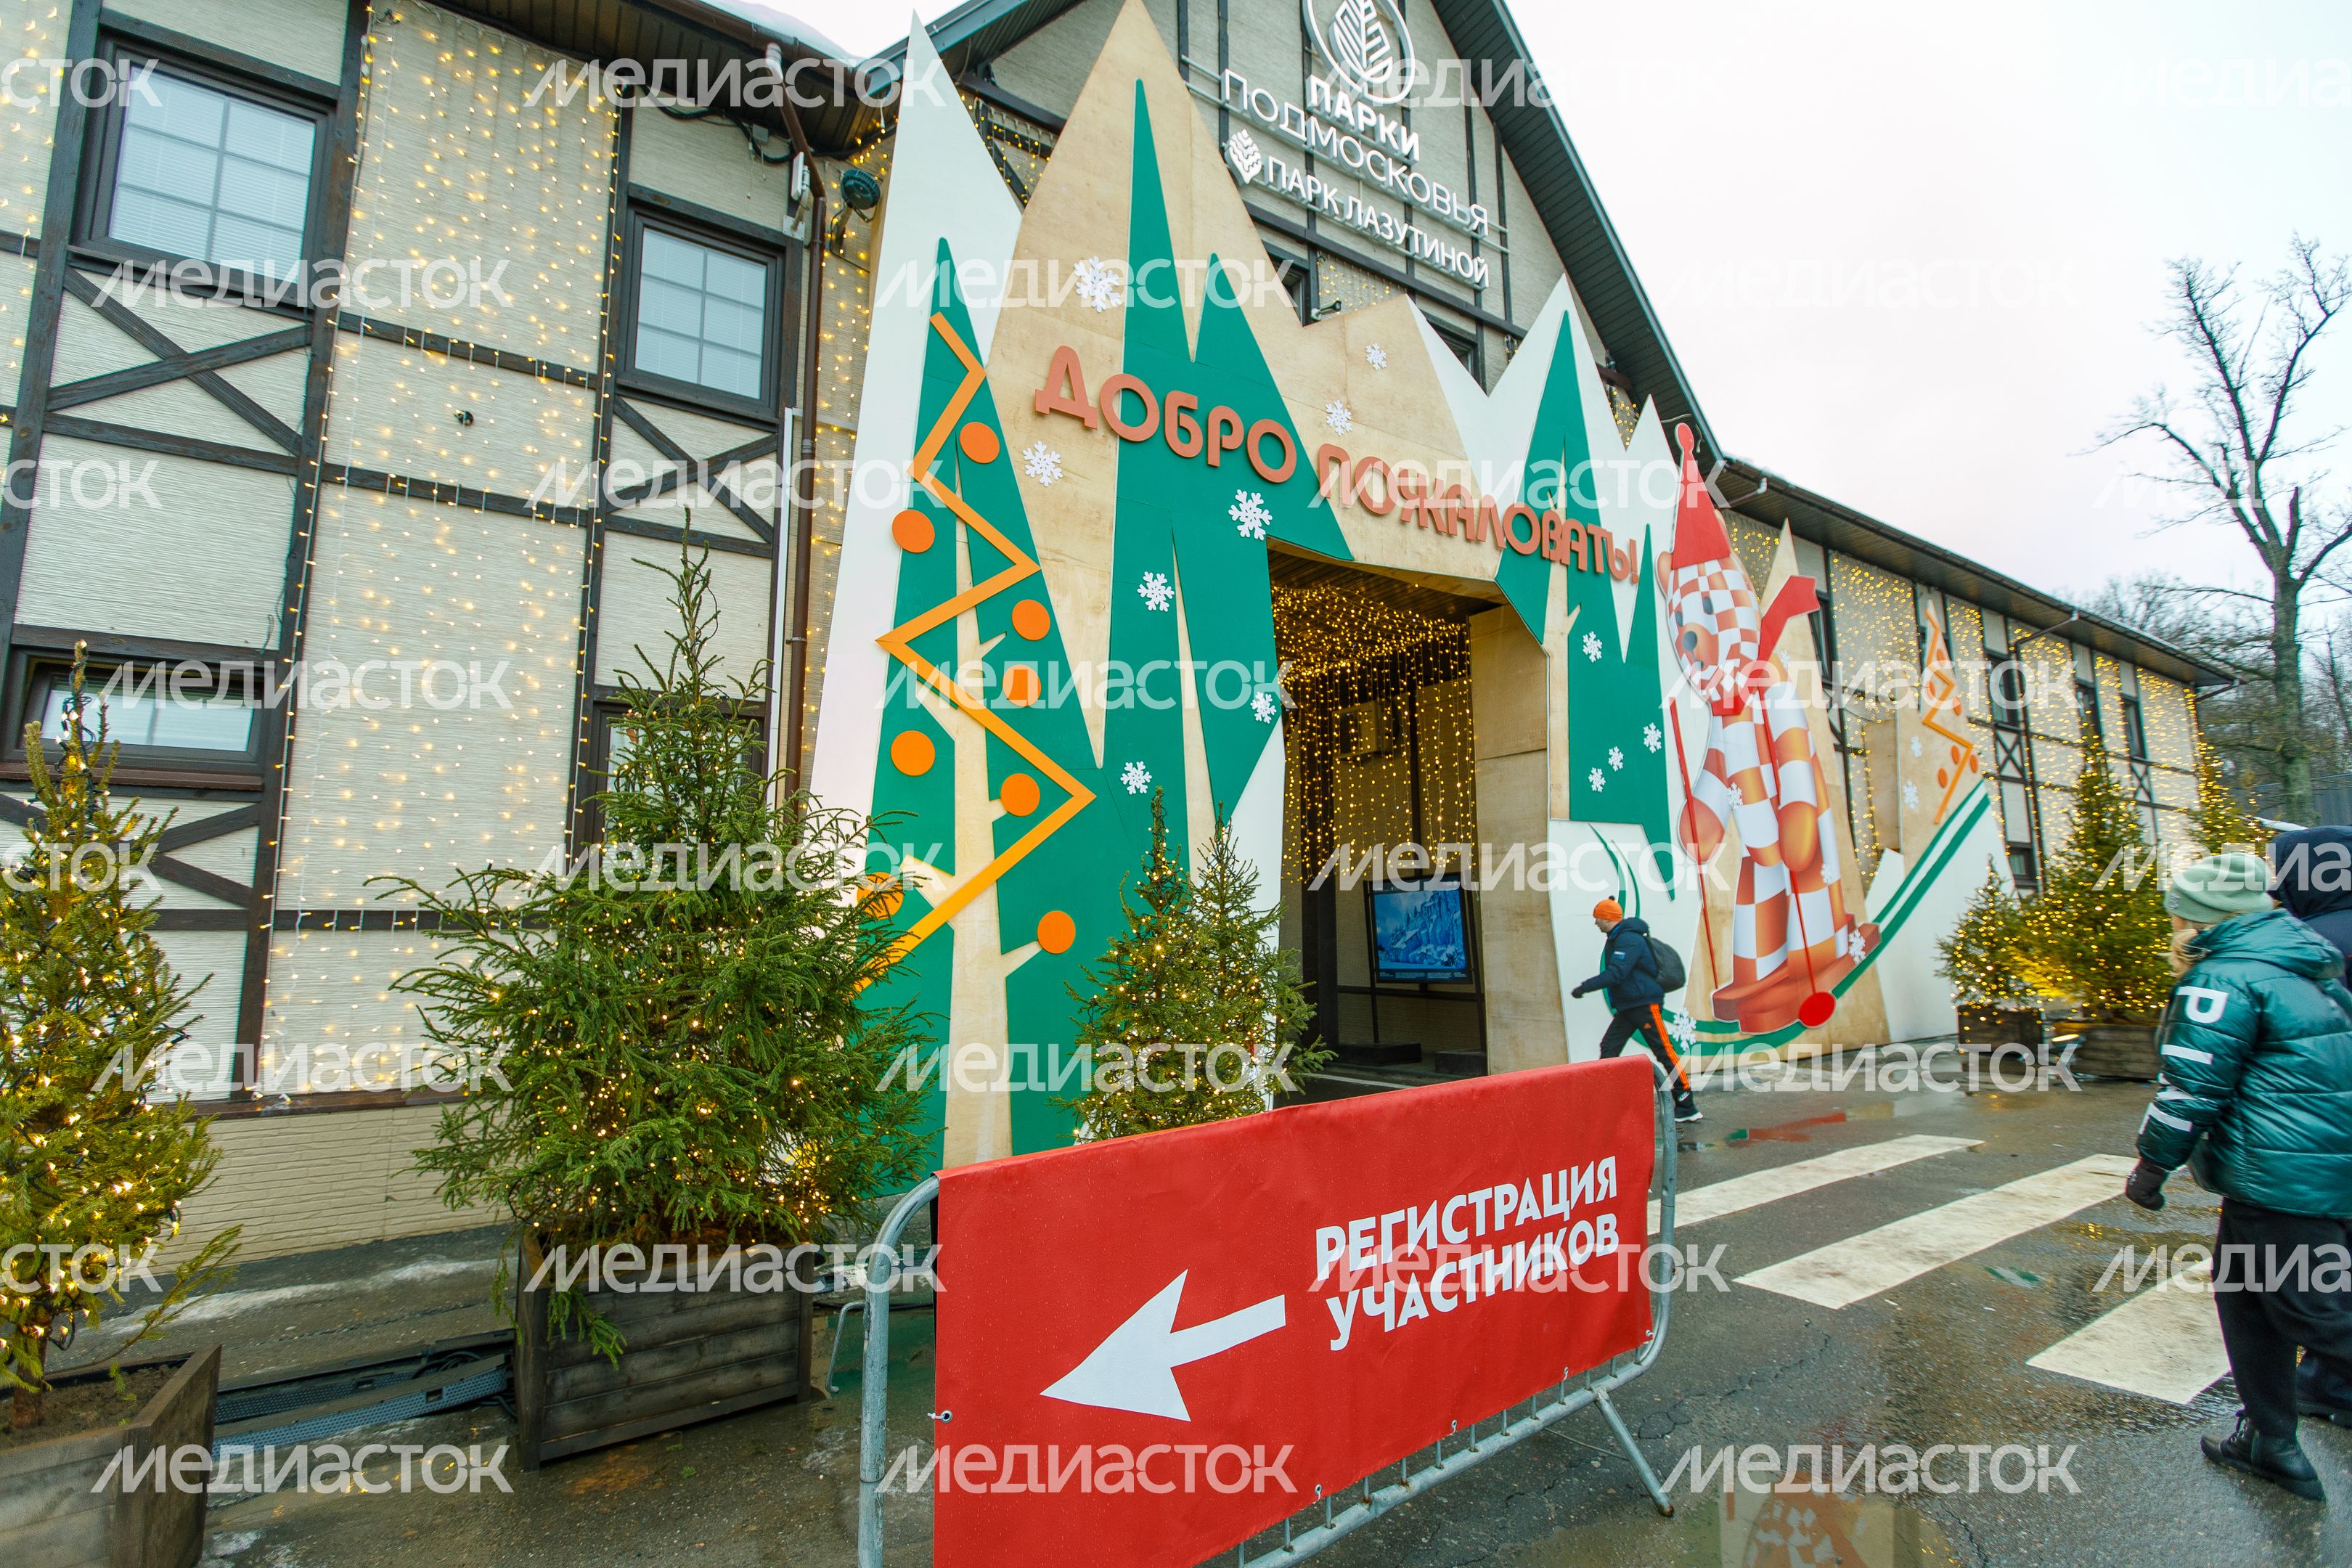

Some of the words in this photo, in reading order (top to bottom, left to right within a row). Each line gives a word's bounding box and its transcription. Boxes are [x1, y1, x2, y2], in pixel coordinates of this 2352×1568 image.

[1221, 68, 1490, 237] ПОДМОСКОВЬЯ
[1308, 74, 1421, 163] ПАРКИ
[1267, 155, 1341, 216] ПАРК
[1344, 195, 1490, 289] ЛАЗУТИНОЙ
[1034, 344, 1297, 483] ДОБРО
[1318, 443, 1640, 584] ПОЖАЛОВАТЬ!
[1315, 1155, 1617, 1282] РЕГИСТРАЦИЯ
[1326, 1212, 1620, 1352] УЧАСТНИКОВ
